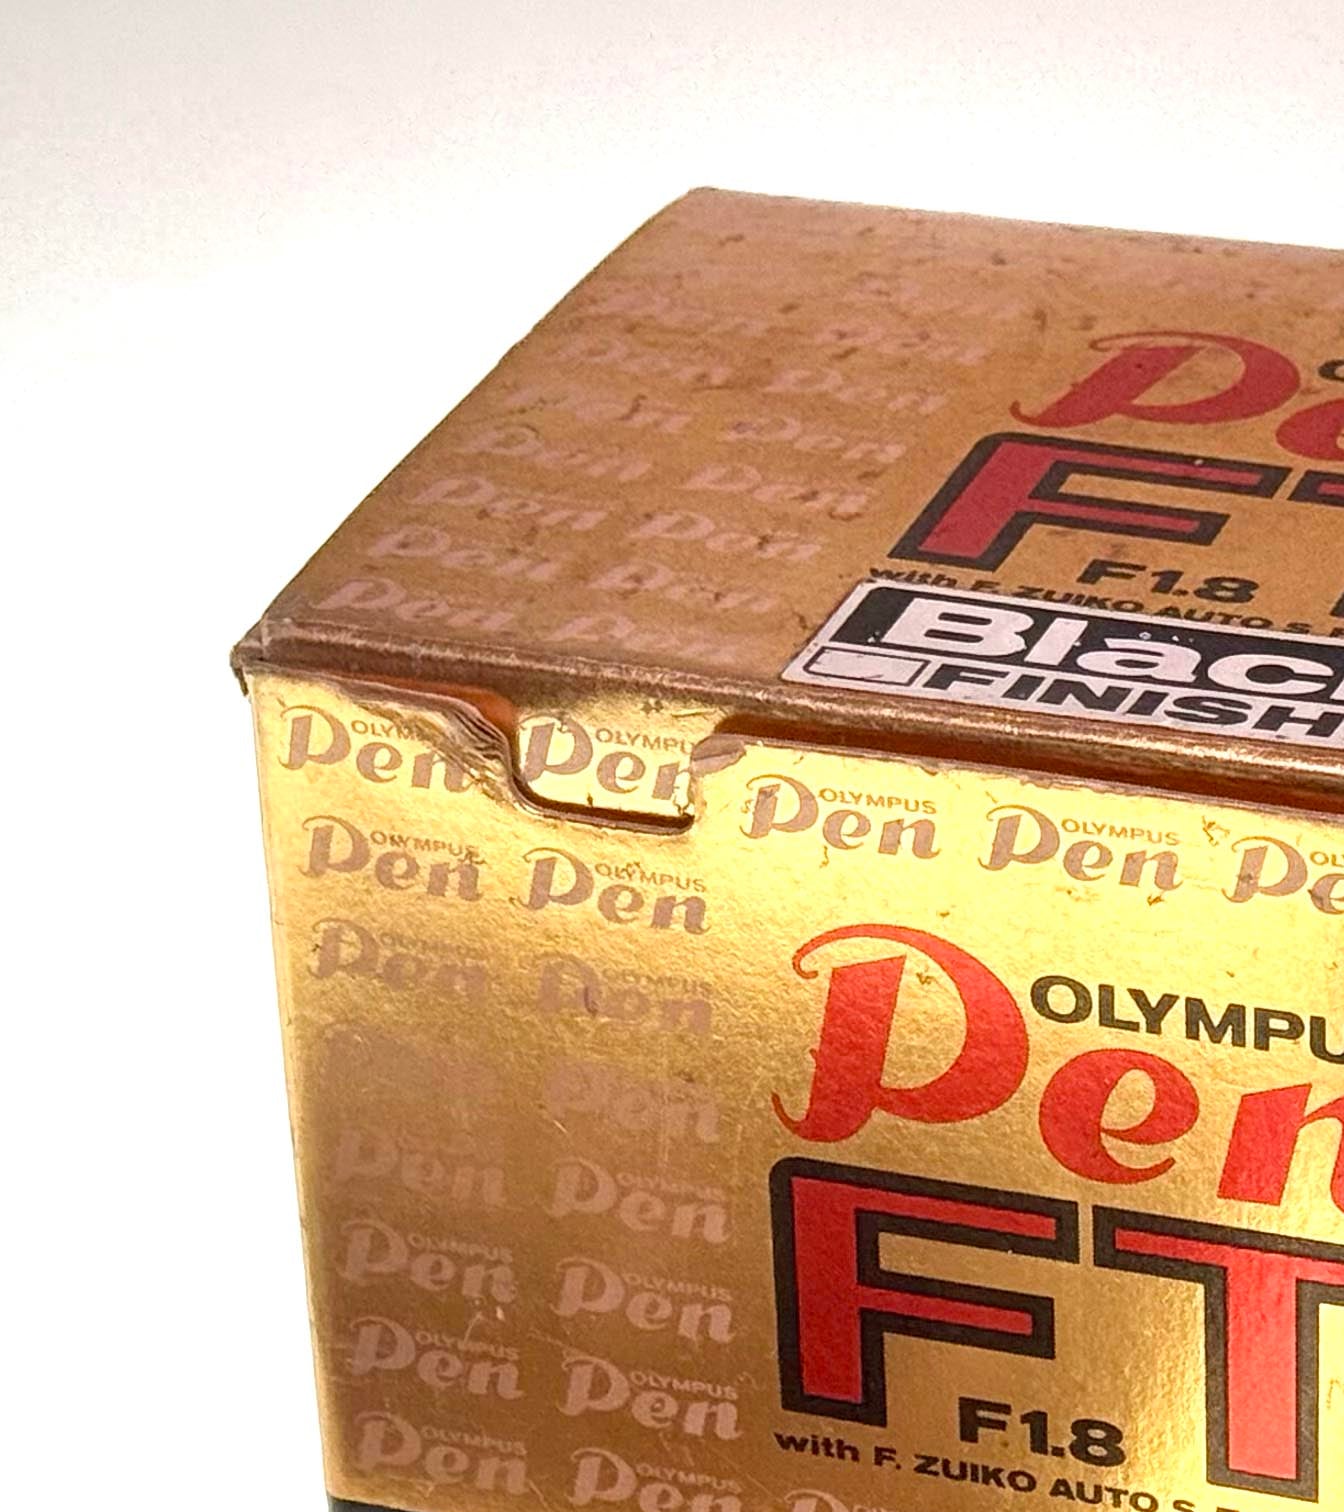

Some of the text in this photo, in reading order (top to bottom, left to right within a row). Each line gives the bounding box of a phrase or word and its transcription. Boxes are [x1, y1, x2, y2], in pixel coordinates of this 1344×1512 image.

[1076, 559, 1256, 604] F1.8
[921, 661, 1344, 738] FINISH
[741, 774, 941, 859] Pen
[818, 787, 937, 815] OLYMPUS
[1060, 818, 1180, 847] OLYMPUS
[297, 815, 483, 900] Pen
[595, 863, 708, 892] OLYMPUS
[978, 804, 1183, 891] Pen
[509, 847, 712, 935] Pen
[549, 1156, 732, 1244] Pen
[338, 1218, 519, 1303] Pen
[552, 1257, 735, 1345] Pen
[351, 1315, 523, 1400] Pen
[558, 1355, 744, 1441] Pen
[631, 1370, 738, 1401] OLYMPUS
[356, 1410, 533, 1495] Pen
[774, 1433, 860, 1465] with
[873, 1445, 902, 1470] F.
[913, 1454, 1038, 1495] ZUIKO
[958, 1395, 1126, 1467] F1.8
